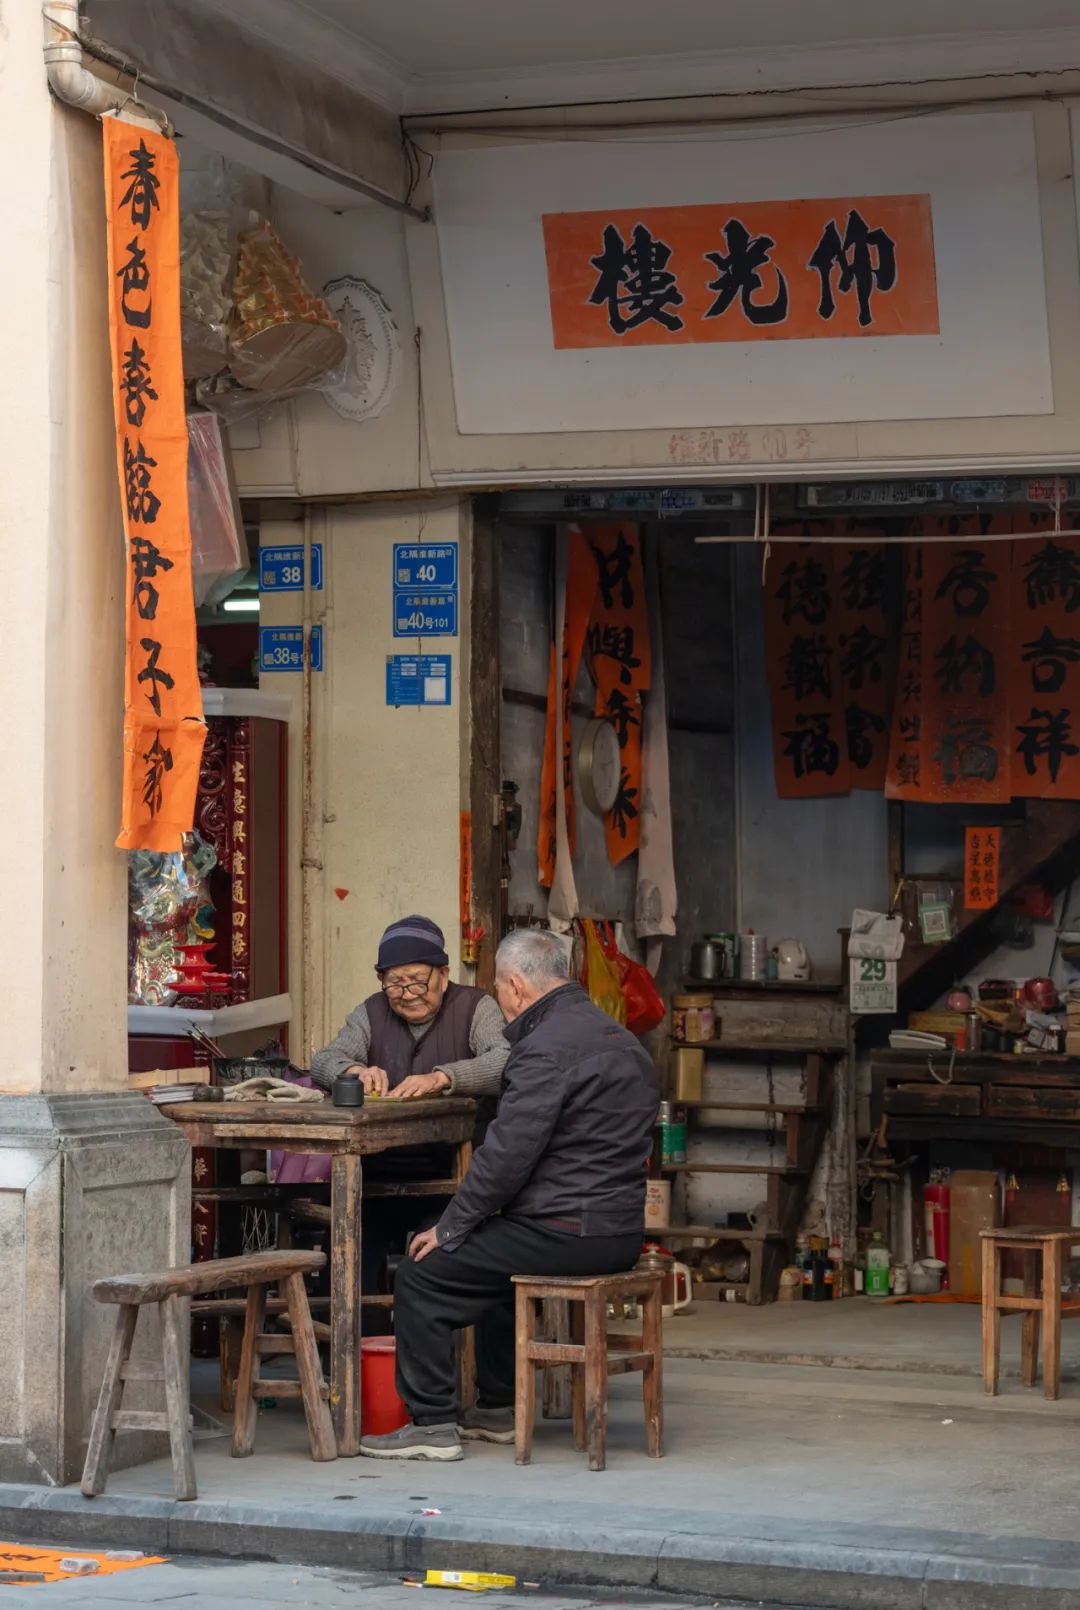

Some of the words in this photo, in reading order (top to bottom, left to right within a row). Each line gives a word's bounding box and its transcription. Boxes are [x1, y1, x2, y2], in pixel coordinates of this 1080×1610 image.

[282, 567, 301, 584] 38
[416, 564, 436, 582] 40
[408, 612, 449, 630] 40号101
[861, 959, 887, 981] 29
